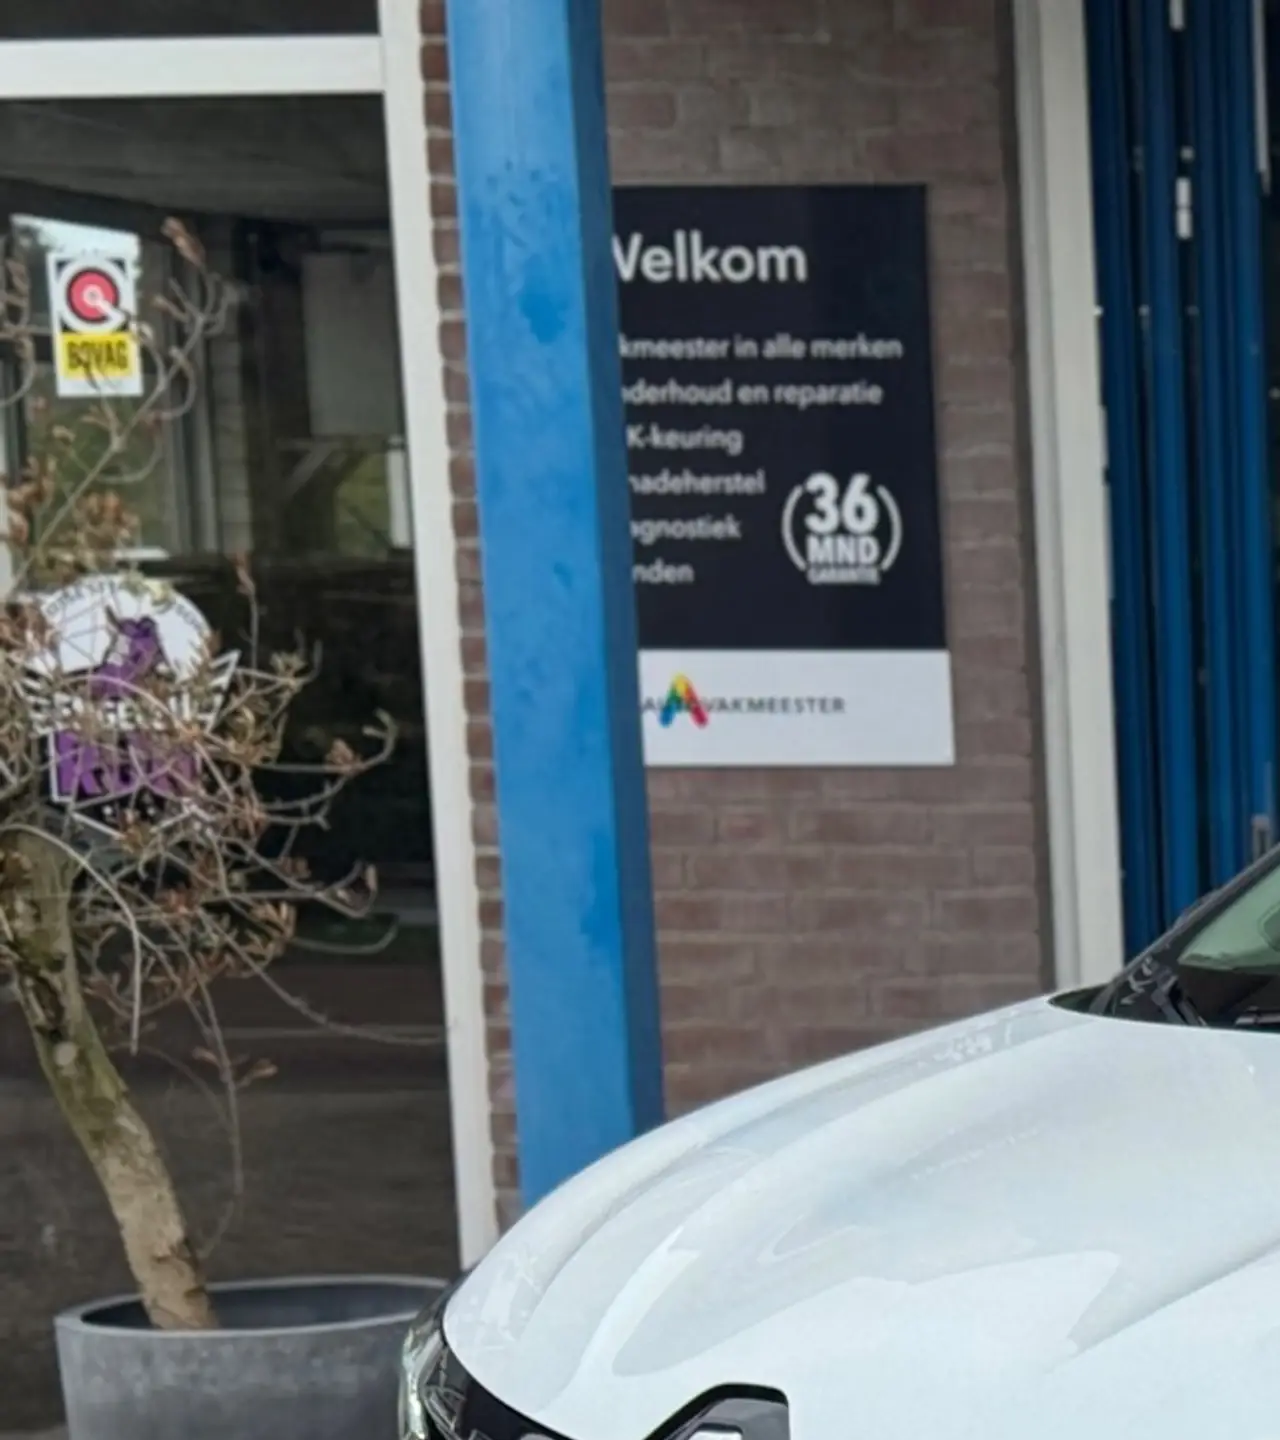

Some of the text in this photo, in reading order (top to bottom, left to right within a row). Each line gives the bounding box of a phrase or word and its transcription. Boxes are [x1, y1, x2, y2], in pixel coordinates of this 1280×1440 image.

[734, 334, 759, 359] in
[763, 333, 807, 359] alle
[811, 333, 904, 359] merken
[736, 384, 770, 404] en
[775, 381, 883, 409] reparatie
[804, 471, 880, 535] 36
[806, 535, 881, 565] MND
